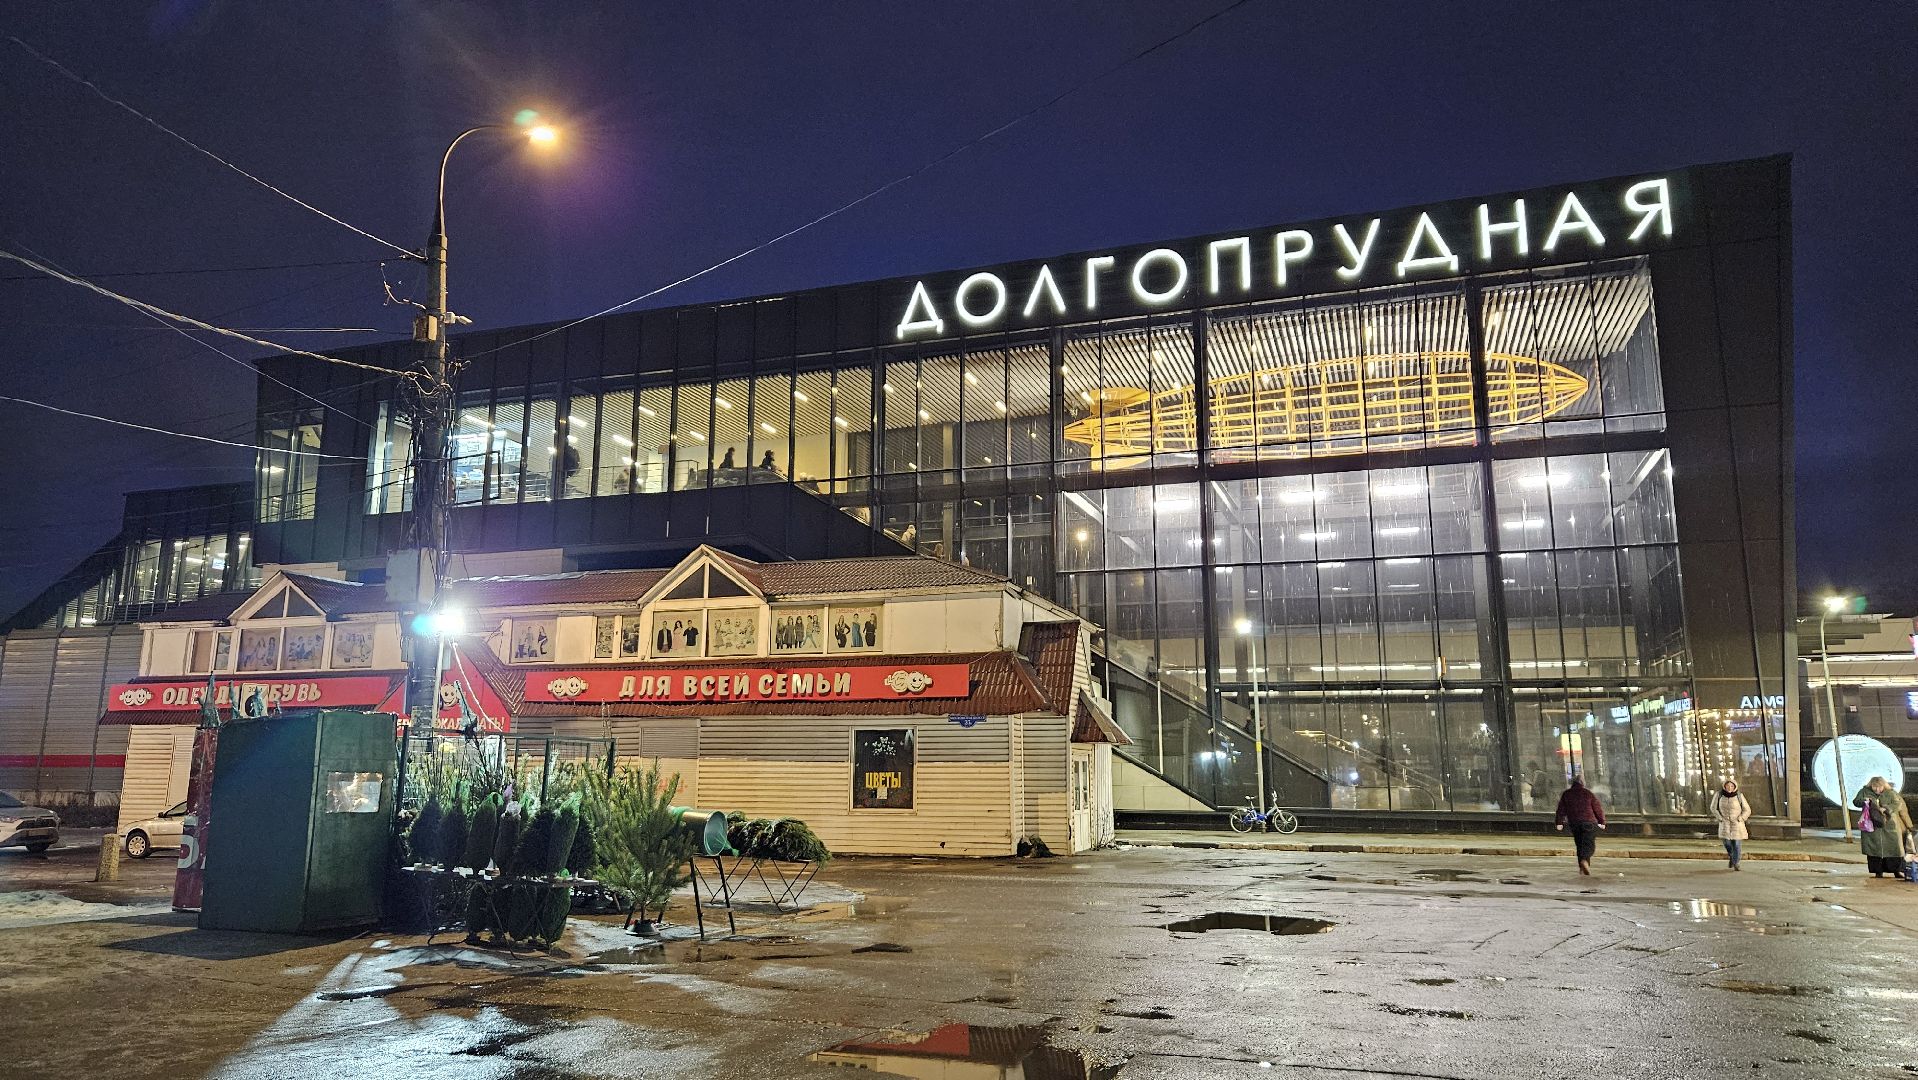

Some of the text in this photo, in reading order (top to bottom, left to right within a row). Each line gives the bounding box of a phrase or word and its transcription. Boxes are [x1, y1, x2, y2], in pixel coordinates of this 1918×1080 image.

[896, 177, 1674, 340] ДОЛГОПРУДНАЯ
[267, 683, 322, 702] БУВЬ
[619, 671, 851, 698] ДЛЯ ВСЕЙ СЕМЬИ
[865, 772, 902, 789] ЦВЕТЫ
